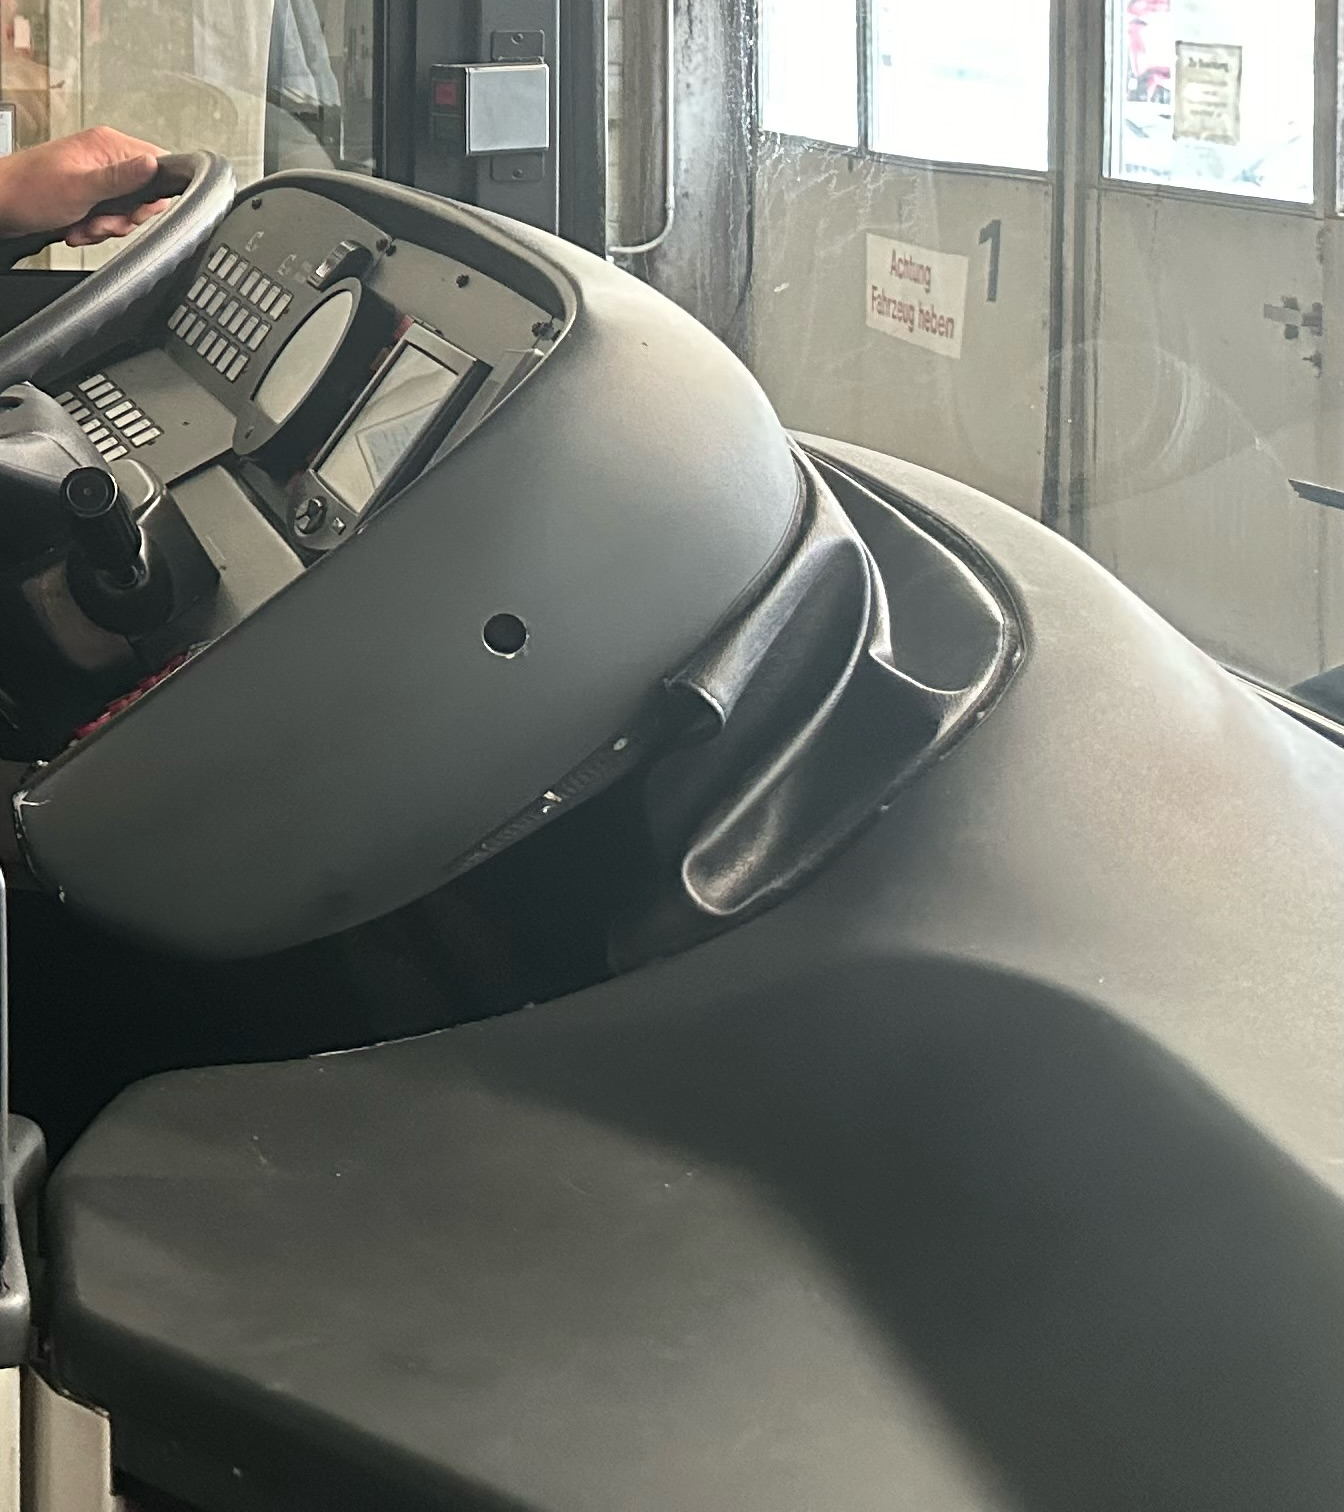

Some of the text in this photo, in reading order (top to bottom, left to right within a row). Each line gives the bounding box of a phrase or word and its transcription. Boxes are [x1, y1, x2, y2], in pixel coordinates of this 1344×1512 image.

[889, 247, 932, 294] Achtung
[978, 219, 1002, 303] 1
[871, 284, 916, 334] Fahrzeug
